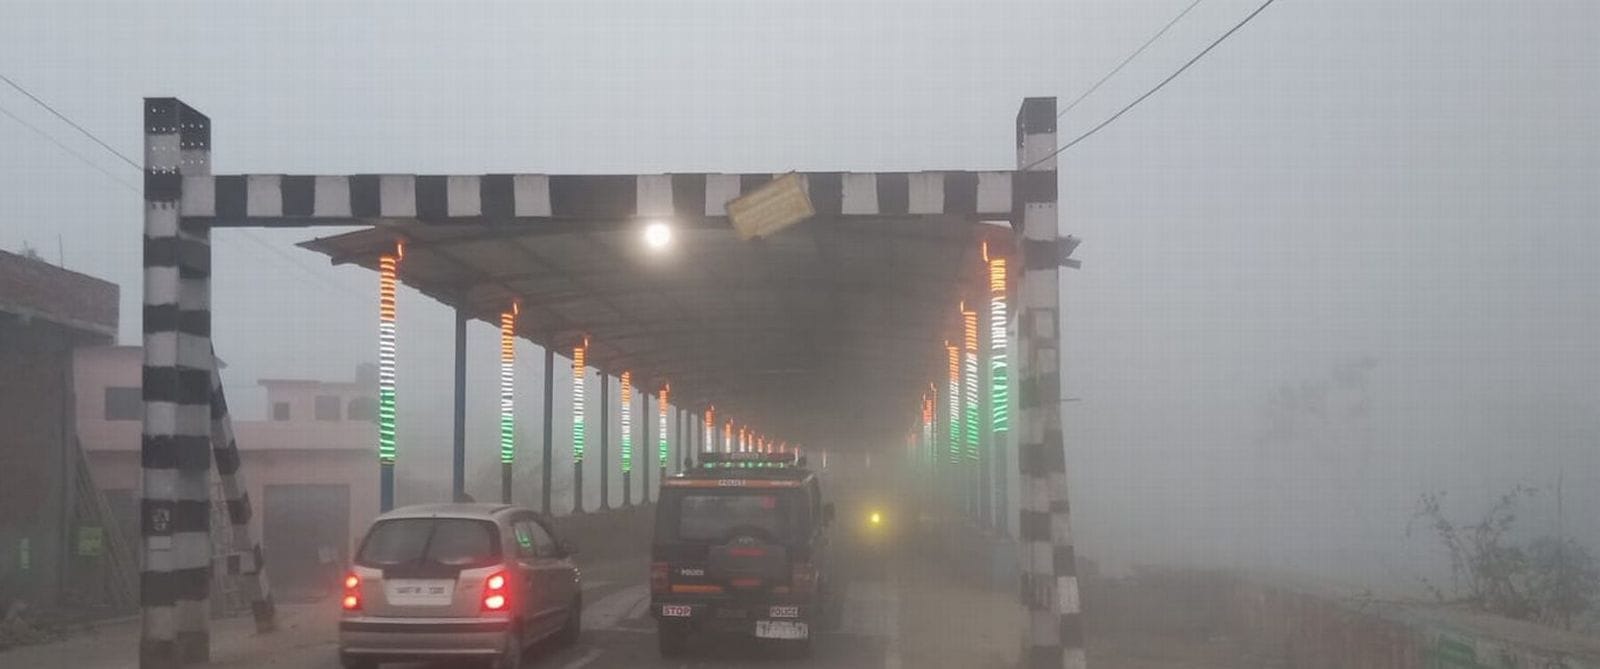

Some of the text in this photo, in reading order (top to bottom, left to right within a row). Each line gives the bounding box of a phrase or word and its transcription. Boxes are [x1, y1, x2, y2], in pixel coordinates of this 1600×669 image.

[681, 568, 704, 576] POLICE
[663, 606, 690, 617] STOP
[770, 607, 798, 617] POLICE
